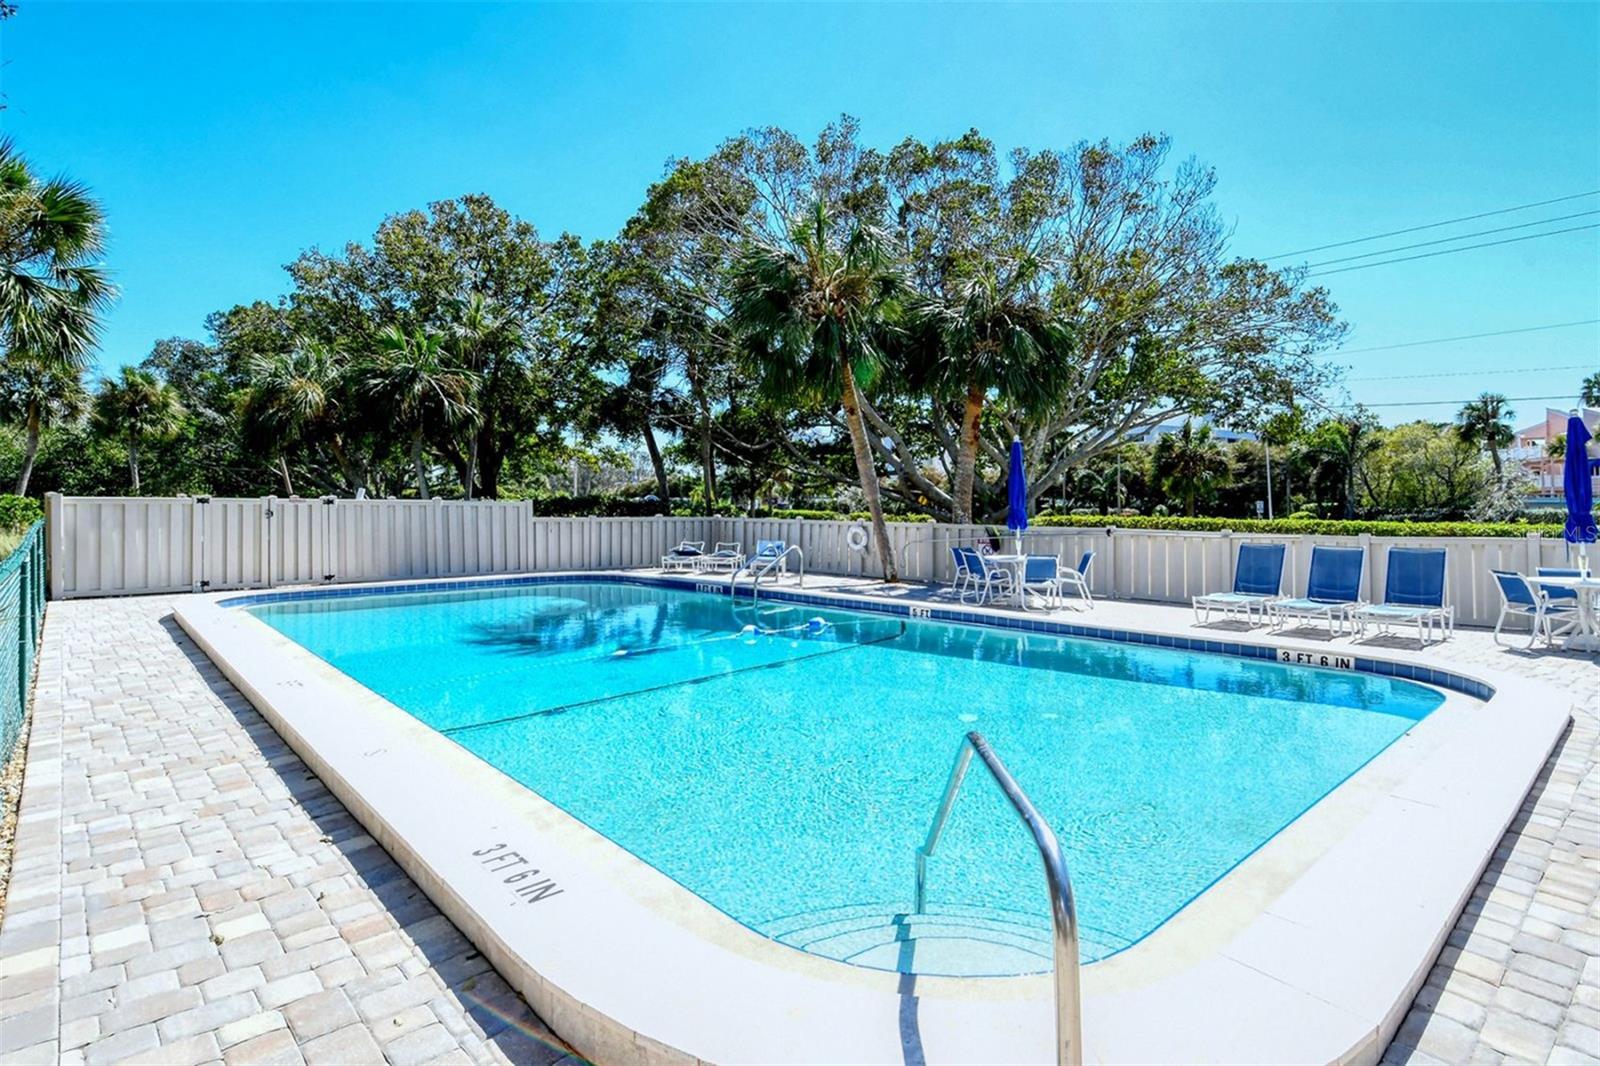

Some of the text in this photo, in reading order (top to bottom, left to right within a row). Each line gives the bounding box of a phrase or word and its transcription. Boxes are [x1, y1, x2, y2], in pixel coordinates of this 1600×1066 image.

[1282, 651, 1350, 668] 3 FT 6 IN
[472, 843, 564, 903] 3 FT 6 IN
